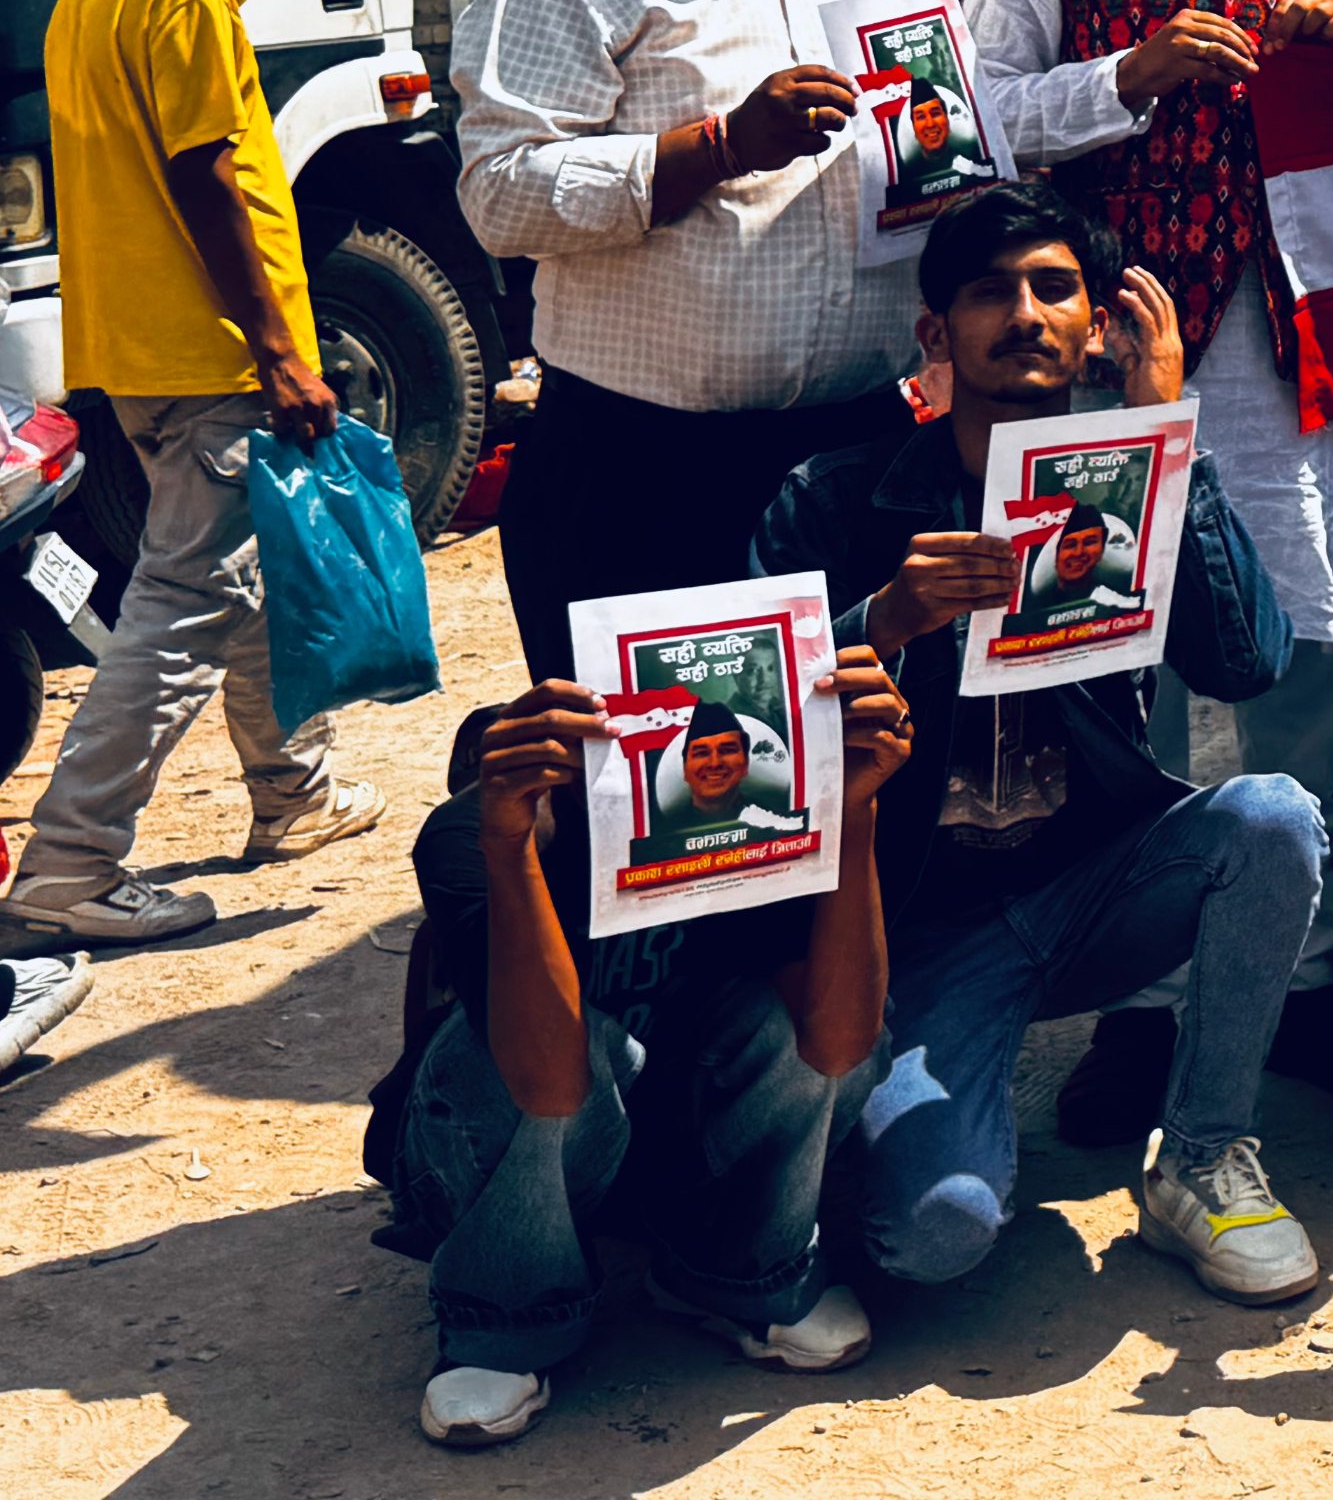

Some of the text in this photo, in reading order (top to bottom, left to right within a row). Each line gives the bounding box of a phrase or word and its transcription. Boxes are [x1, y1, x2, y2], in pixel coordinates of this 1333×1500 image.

[658, 635, 754, 666] सही व्यक्ति
[675, 660, 708, 683] सही
